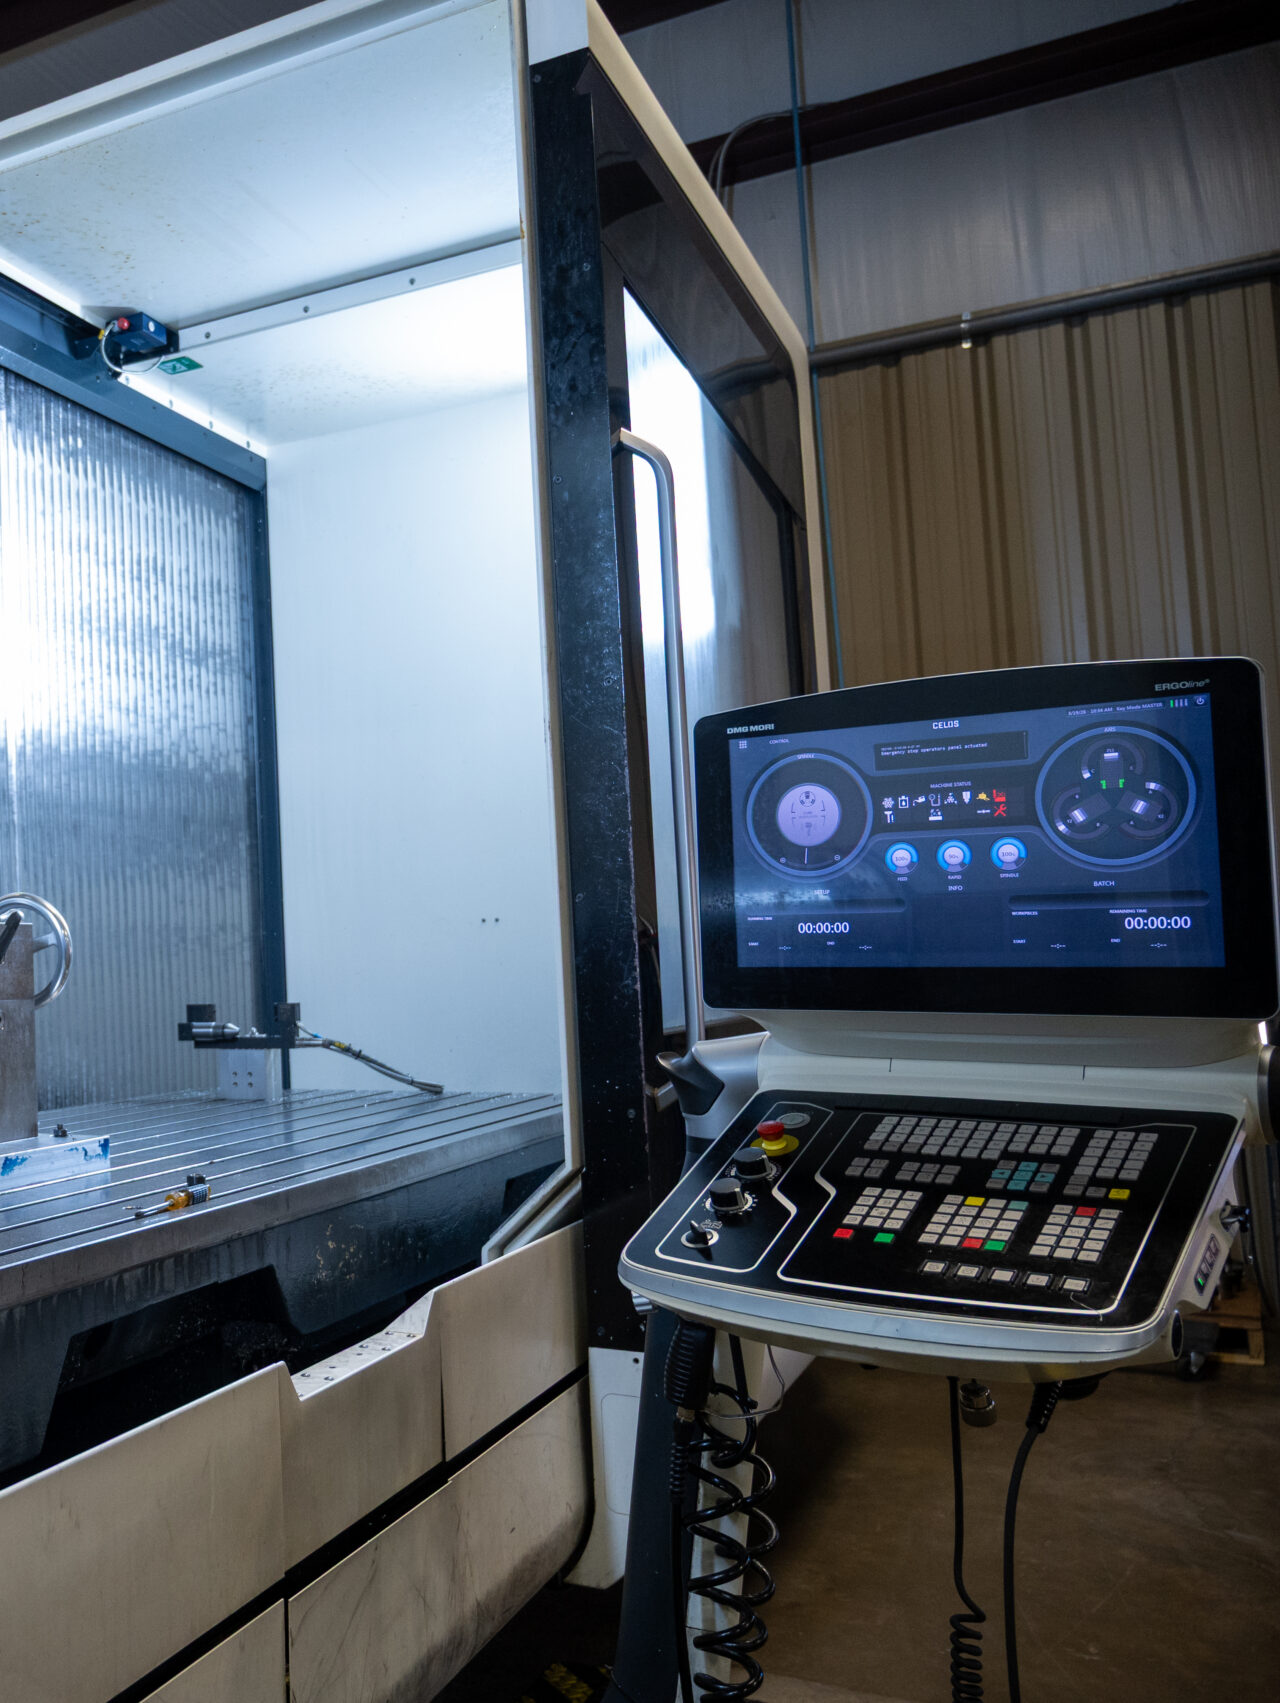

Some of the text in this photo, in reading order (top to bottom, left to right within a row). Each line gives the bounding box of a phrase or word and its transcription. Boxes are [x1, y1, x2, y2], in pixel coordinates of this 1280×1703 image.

[726, 723, 775, 734] DMG MORI
[932, 720, 960, 729] CELOS
[797, 922, 849, 933] 00:00:00
[1124, 916, 1191, 930] 00:00:00
